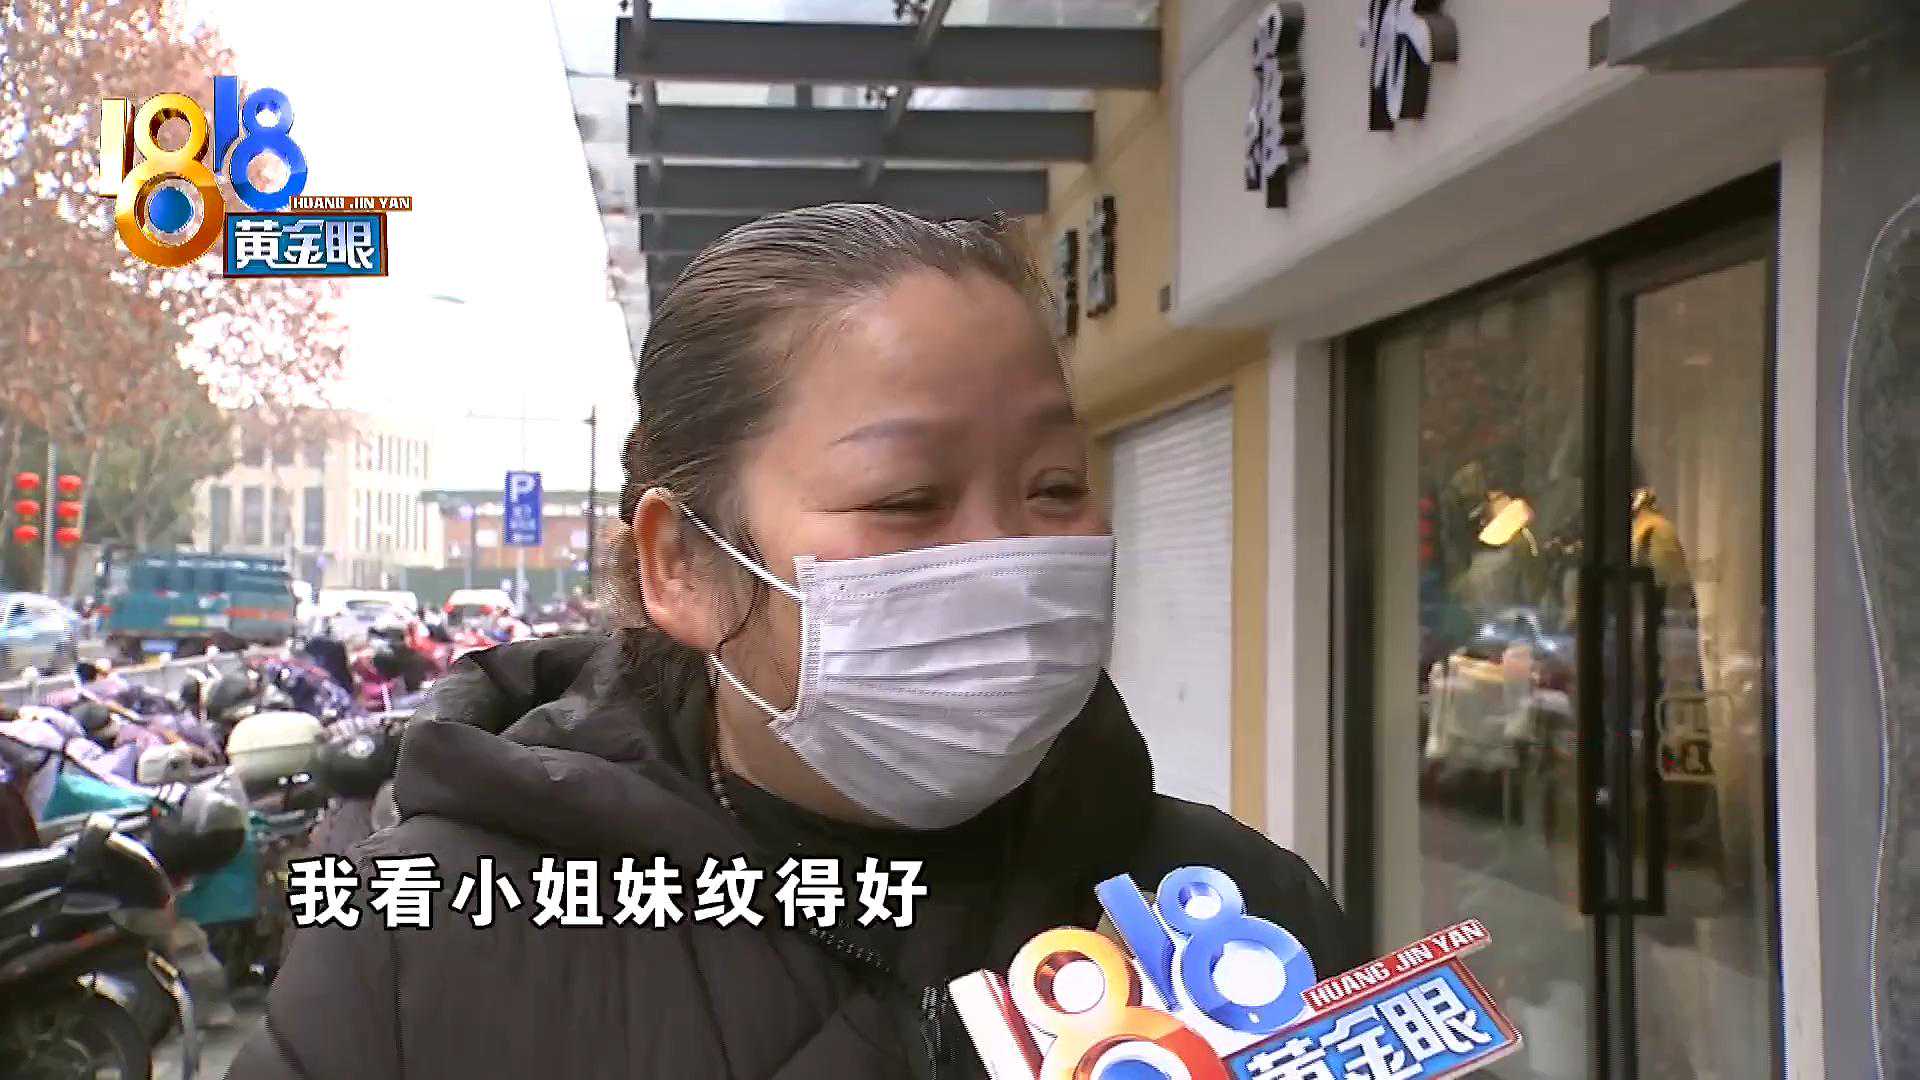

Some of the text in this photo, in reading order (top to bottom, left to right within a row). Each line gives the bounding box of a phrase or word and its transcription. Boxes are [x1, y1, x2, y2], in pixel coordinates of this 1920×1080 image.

[510, 474, 536, 503] P
[1308, 919, 1485, 1010] HUANG JIN YAN
